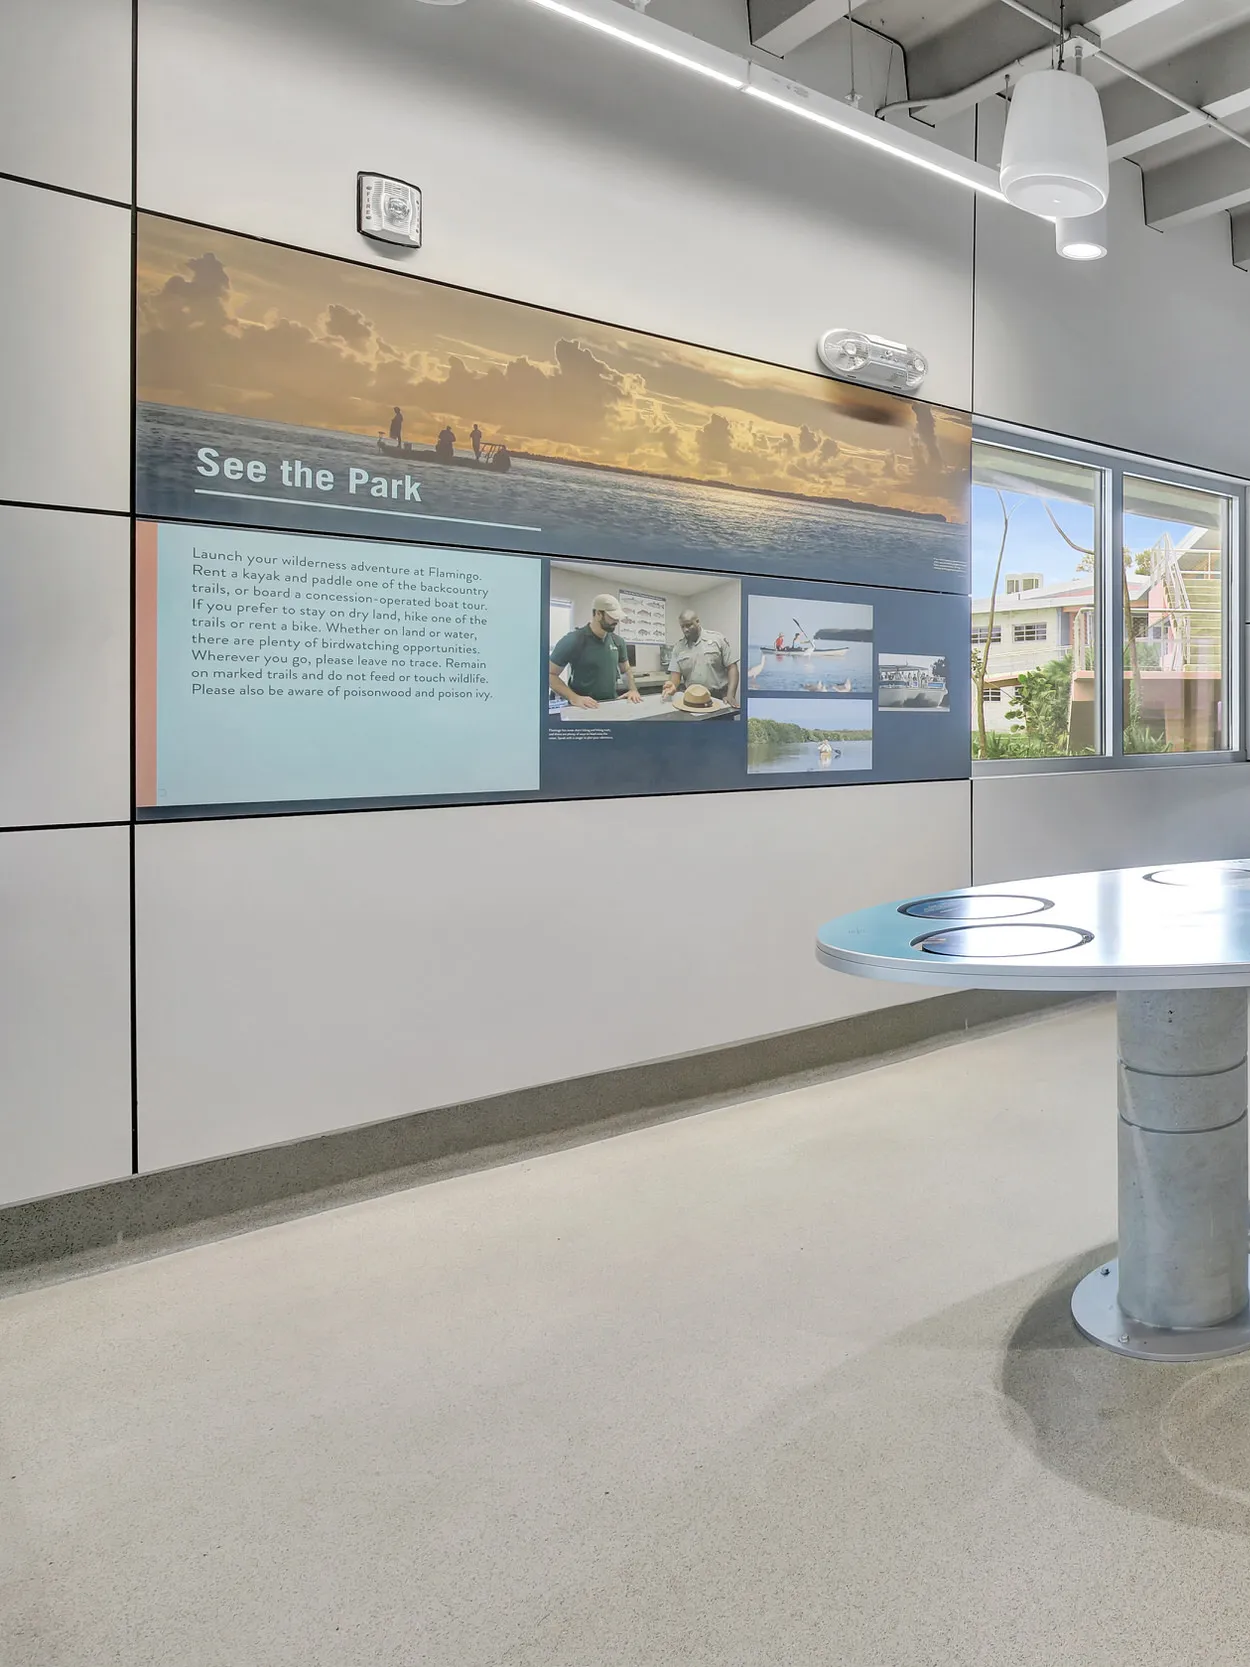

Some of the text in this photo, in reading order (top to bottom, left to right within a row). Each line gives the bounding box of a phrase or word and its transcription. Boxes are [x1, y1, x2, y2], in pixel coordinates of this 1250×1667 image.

[196, 447, 422, 502] See the Park
[193, 547, 482, 583] Launch your wilderness adventure at Flamingo.
[192, 564, 226, 578] Rent
[243, 568, 280, 584] kayak
[284, 573, 308, 583] and
[312, 575, 352, 587] paddle
[356, 581, 378, 589] one
[382, 579, 395, 589] of
[398, 581, 417, 591] the
[420, 582, 489, 599] backcountry
[192, 583, 230, 596] trails,
[234, 588, 249, 596] or
[253, 586, 290, 599] board
[306, 592, 431, 608] concession-operated
[435, 598, 459, 609] boat
[462, 602, 488, 611] tour.
[192, 598, 204, 609] If
[207, 603, 232, 614] you
[237, 602, 278, 615] prefer
[282, 606, 295, 615] to
[300, 607, 326, 620] stay
[348, 608, 369, 622] dry
[373, 609, 401, 623] land,
[404, 611, 428, 622] hike
[455, 614, 467, 624] of
[469, 615, 488, 625] the
[192, 617, 225, 628] trails
[230, 621, 244, 629] or
[249, 621, 276, 631] rent
[292, 621, 321, 633] bike.
[326, 622, 380, 635] Whether
[383, 628, 398, 636] on
[402, 626, 425, 638] land
[444, 631, 477, 641] water,
[192, 633, 480, 655] there are plenty of birdwatching opportunities.
[191, 649, 487, 669] Wherever you go, please leave no trace. Remain
[191, 670, 209, 678] on
[213, 668, 263, 679] marked
[267, 669, 298, 680] trails
[301, 670, 324, 680] and
[327, 670, 342, 681] do
[346, 673, 366, 681] not
[370, 671, 395, 682] feed
[414, 673, 445, 683] touch
[449, 673, 489, 684] wildlife.
[192, 683, 493, 701] Please also be aware of poisonwood and poison ivy.
